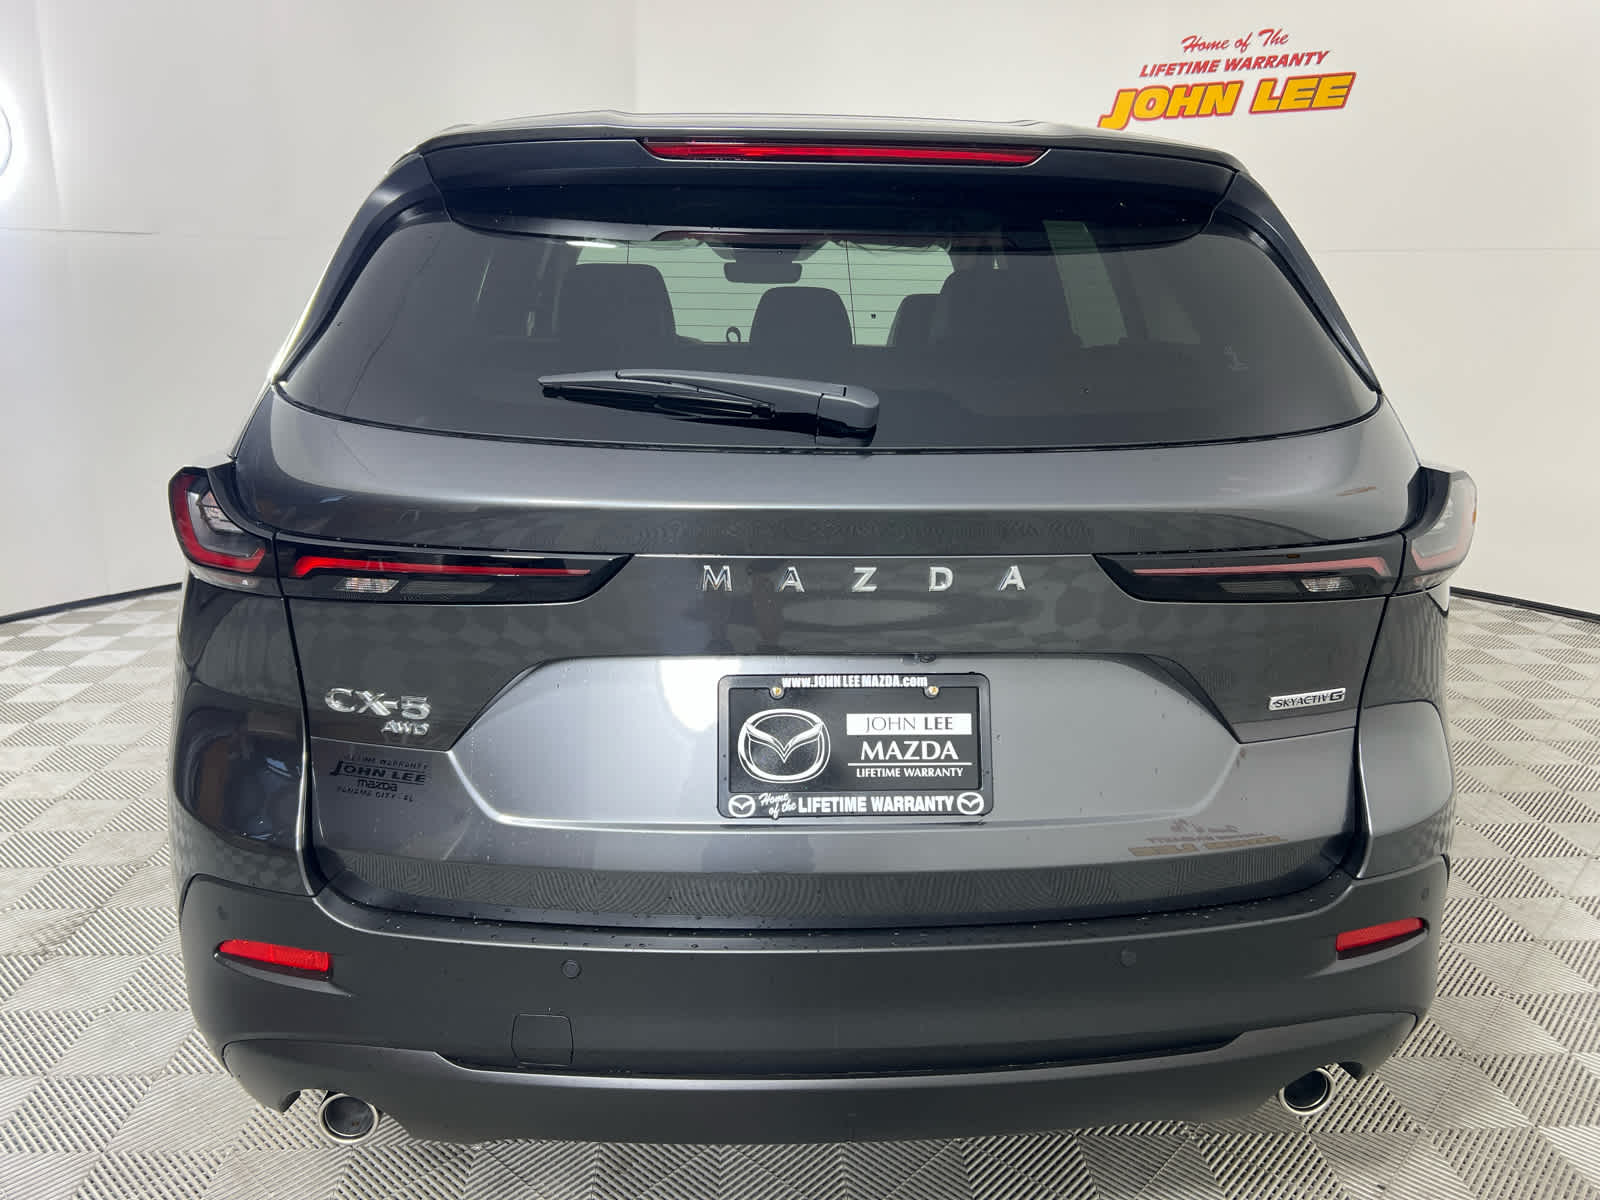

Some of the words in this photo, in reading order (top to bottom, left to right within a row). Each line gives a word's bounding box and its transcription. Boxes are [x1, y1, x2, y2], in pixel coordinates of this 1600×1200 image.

[1181, 34, 1230, 53] Home
[1234, 32, 1253, 54] of
[1258, 28, 1289, 47] The
[1139, 59, 1221, 78] LIFETIME
[1224, 50, 1330, 72] WARRANTY
[1097, 80, 1244, 130] JOHN
[1249, 72, 1357, 115] LEE
[702, 565, 1026, 592] MAZDA
[325, 688, 432, 719] CX-5
[381, 720, 430, 735] AWD
[866, 716, 917, 733] JOHN
[924, 716, 953, 731] LEE
[860, 740, 959, 760] MAZDA
[329, 760, 386, 777] JOHN
[391, 771, 426, 783] LEE
[856, 767, 901, 778] LIFETIME
[903, 767, 963, 778] WARRANTY
[759, 792, 789, 806] Home
[768, 802, 780, 819] of
[782, 799, 797, 812] the
[798, 796, 867, 813] LIFETIME
[871, 795, 954, 813] WARRANTY
